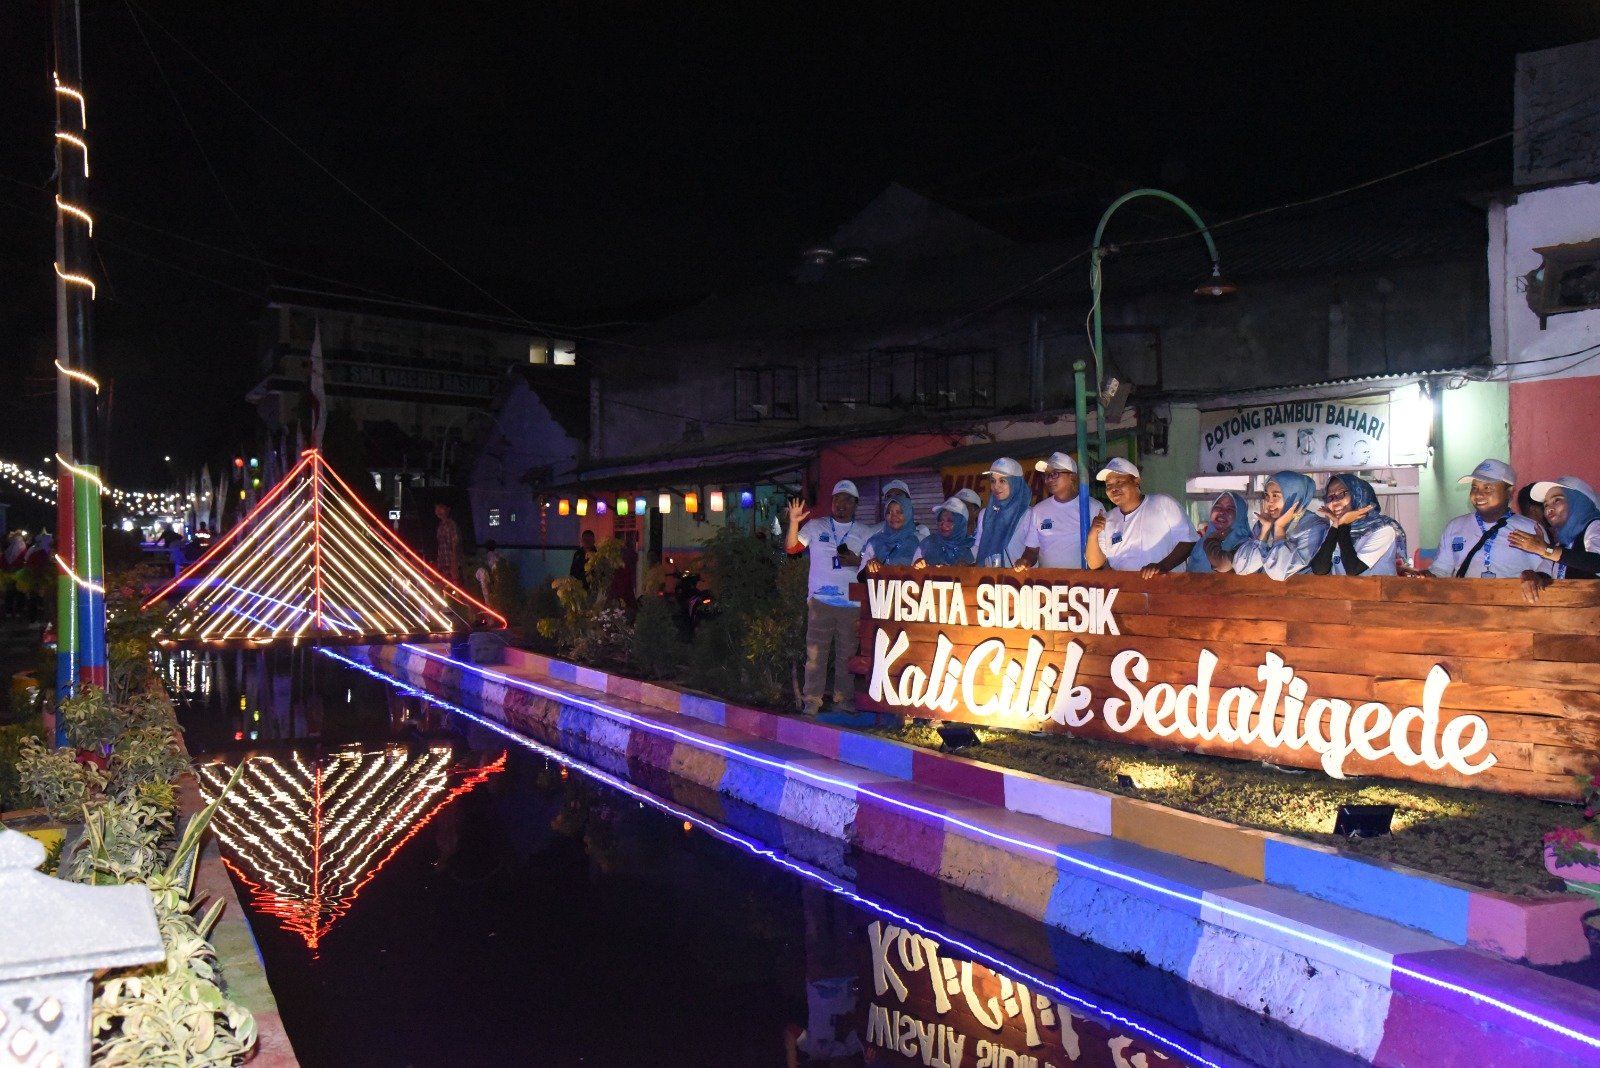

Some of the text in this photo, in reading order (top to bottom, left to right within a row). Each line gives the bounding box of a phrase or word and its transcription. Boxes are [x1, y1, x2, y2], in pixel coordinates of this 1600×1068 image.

[1204, 403, 1385, 451] POTONG RAMBUT BAHARI
[867, 578, 1120, 635] WISATA SIDORESIK
[1103, 648, 1498, 779] Sedatigede
